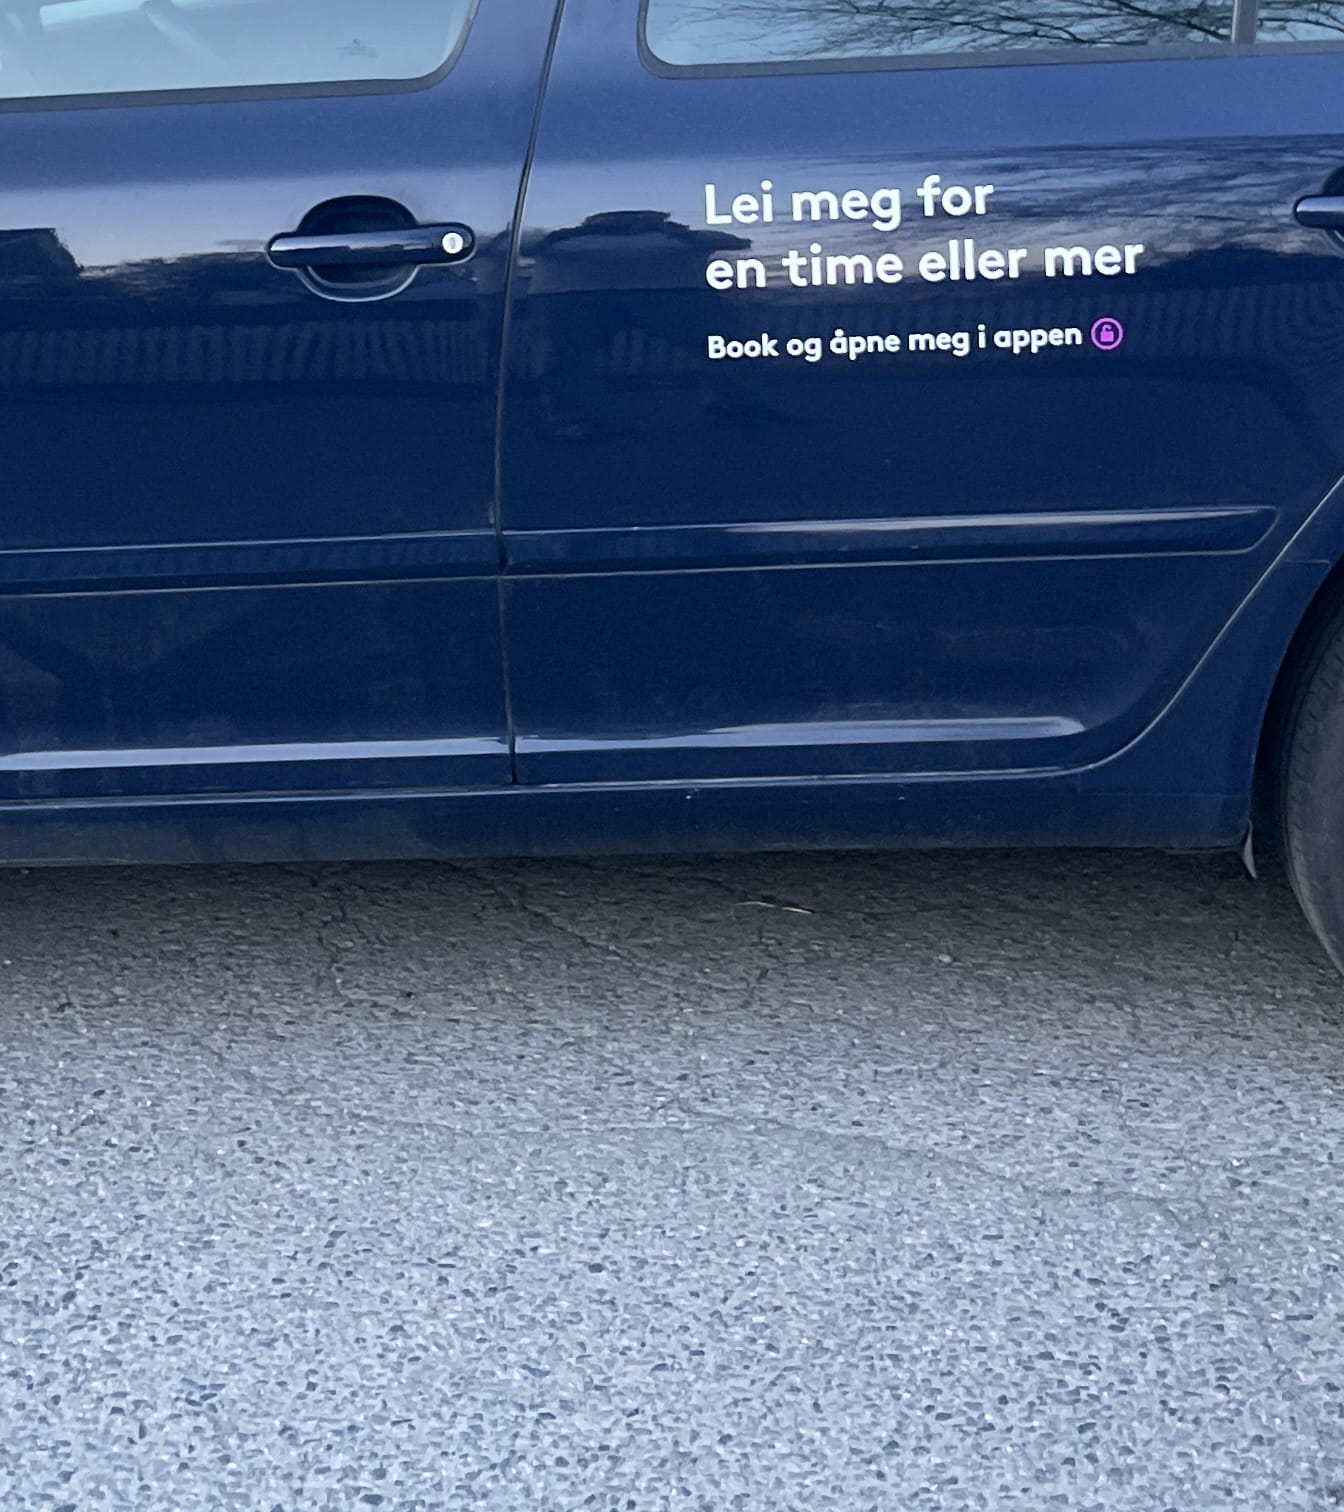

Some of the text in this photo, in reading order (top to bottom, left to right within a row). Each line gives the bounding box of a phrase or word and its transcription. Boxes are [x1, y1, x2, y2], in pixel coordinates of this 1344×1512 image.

[704, 173, 995, 232] Lei meg for
[705, 238, 1145, 290] en time eller mer
[707, 323, 1083, 363] Book og åpne meg i appen
